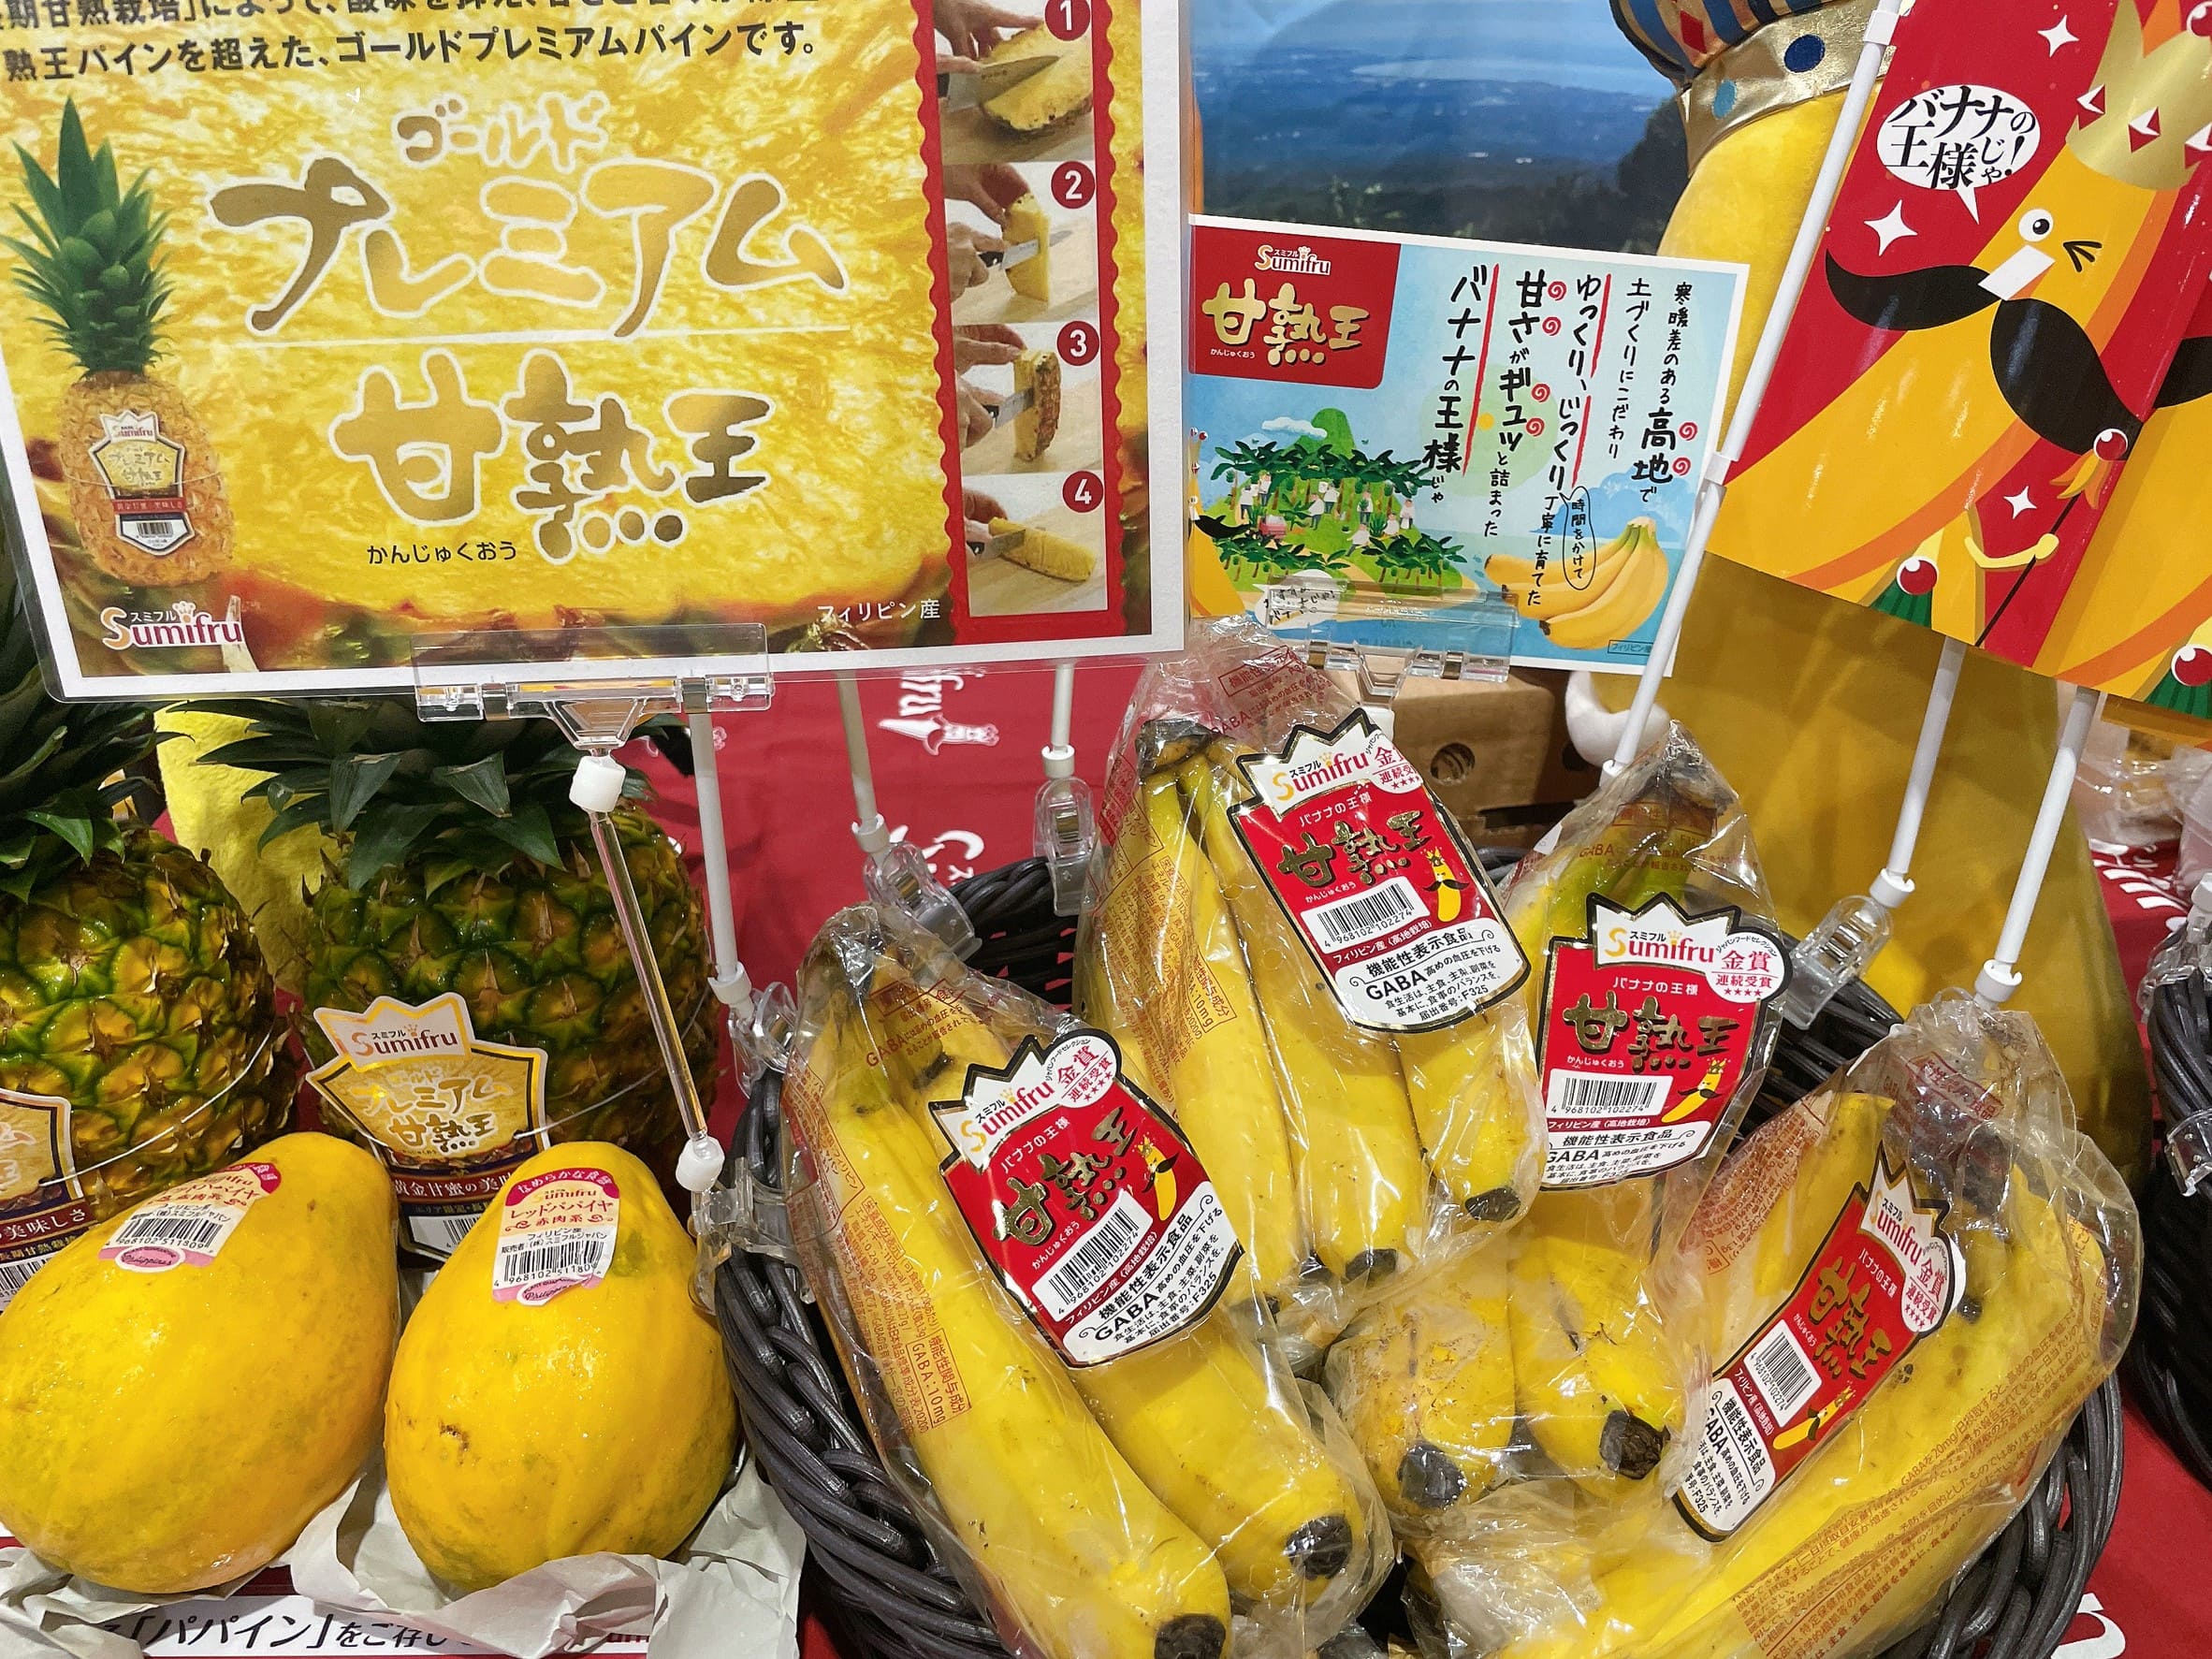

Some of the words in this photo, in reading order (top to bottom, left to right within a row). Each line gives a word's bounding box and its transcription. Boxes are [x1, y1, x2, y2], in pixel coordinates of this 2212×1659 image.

[396, 91, 611, 174] ゴールド
[1889, 85, 2036, 140] バナナの
[205, 154, 848, 341] プレミアム
[1255, 244, 1332, 275] Sumifru
[1273, 248, 1299, 258] スミフル
[1201, 278, 1370, 366] 甘熟王
[1210, 348, 1256, 359] かんじゅくおう
[1608, 277, 1652, 459] 土づくりにこだわり
[1631, 282, 1693, 502] 寒暖差のある高地で
[328, 348, 775, 563] 甘熟王
[367, 541, 517, 565] かんじゅくおう
[100, 606, 245, 649] Sumifru
[131, 611, 177, 624] スミフル
[818, 599, 941, 622] フィリピン産
[1272, 753, 1370, 801] Sumifru
[1288, 760, 1321, 779] スミフル
[1299, 792, 1373, 827] バナナの王様
[1277, 810, 1433, 887] 甘熟王
[1304, 881, 1357, 904] かんじゅくおう
[1336, 926, 1374, 944] 968102
[1375, 909, 1413, 932] 102274
[1605, 927, 1714, 963] Sumifru
[1629, 930, 1666, 941] スミフル
[1365, 927, 1473, 978] 機能性表示食品
[1721, 950, 1771, 972] 金賞
[1365, 970, 1428, 1001] GABA
[1613, 976, 1698, 996] バナナの王様
[1716, 974, 1772, 988] 連続受賞
[351, 1029, 458, 1056] Sumifru
[371, 1029, 405, 1039] スミフル
[1563, 991, 1740, 1074] 甘熟王
[1056, 1046, 1099, 1088] 金賞
[1070, 1058, 1113, 1102] 連続受賞
[349, 1077, 514, 1115] プレミアム
[962, 1079, 1054, 1152] Sumifru
[975, 1099, 1005, 1124] スミフル
[388, 1113, 499, 1156] 甘熟王
[999, 1116, 1070, 1173] バナナの王様
[1563, 1129, 1673, 1146] 機能性表示食品
[994, 1106, 1138, 1246] 甘熟王
[0, 1208, 86, 1241] 美味しさ
[511, 1200, 614, 1219] レッドパパイヤ
[1881, 1197, 1904, 1222] スミフル
[1032, 1221, 1081, 1271] かんじゅくおう
[1070, 1267, 1107, 1303] 968102
[1107, 1230, 1141, 1267] 102274
[509, 1271, 551, 1284] 968102
[1099, 1214, 1194, 1321] 機能性表示食品
[1858, 1248, 1898, 1299] バナナの王様
[1095, 1288, 1161, 1342] GABA
[1809, 1256, 1893, 1379] 甘熟王
[926, 1334, 968, 1414] 機能性関与成分
[1723, 1396, 1762, 1476] 機能性表示食品
